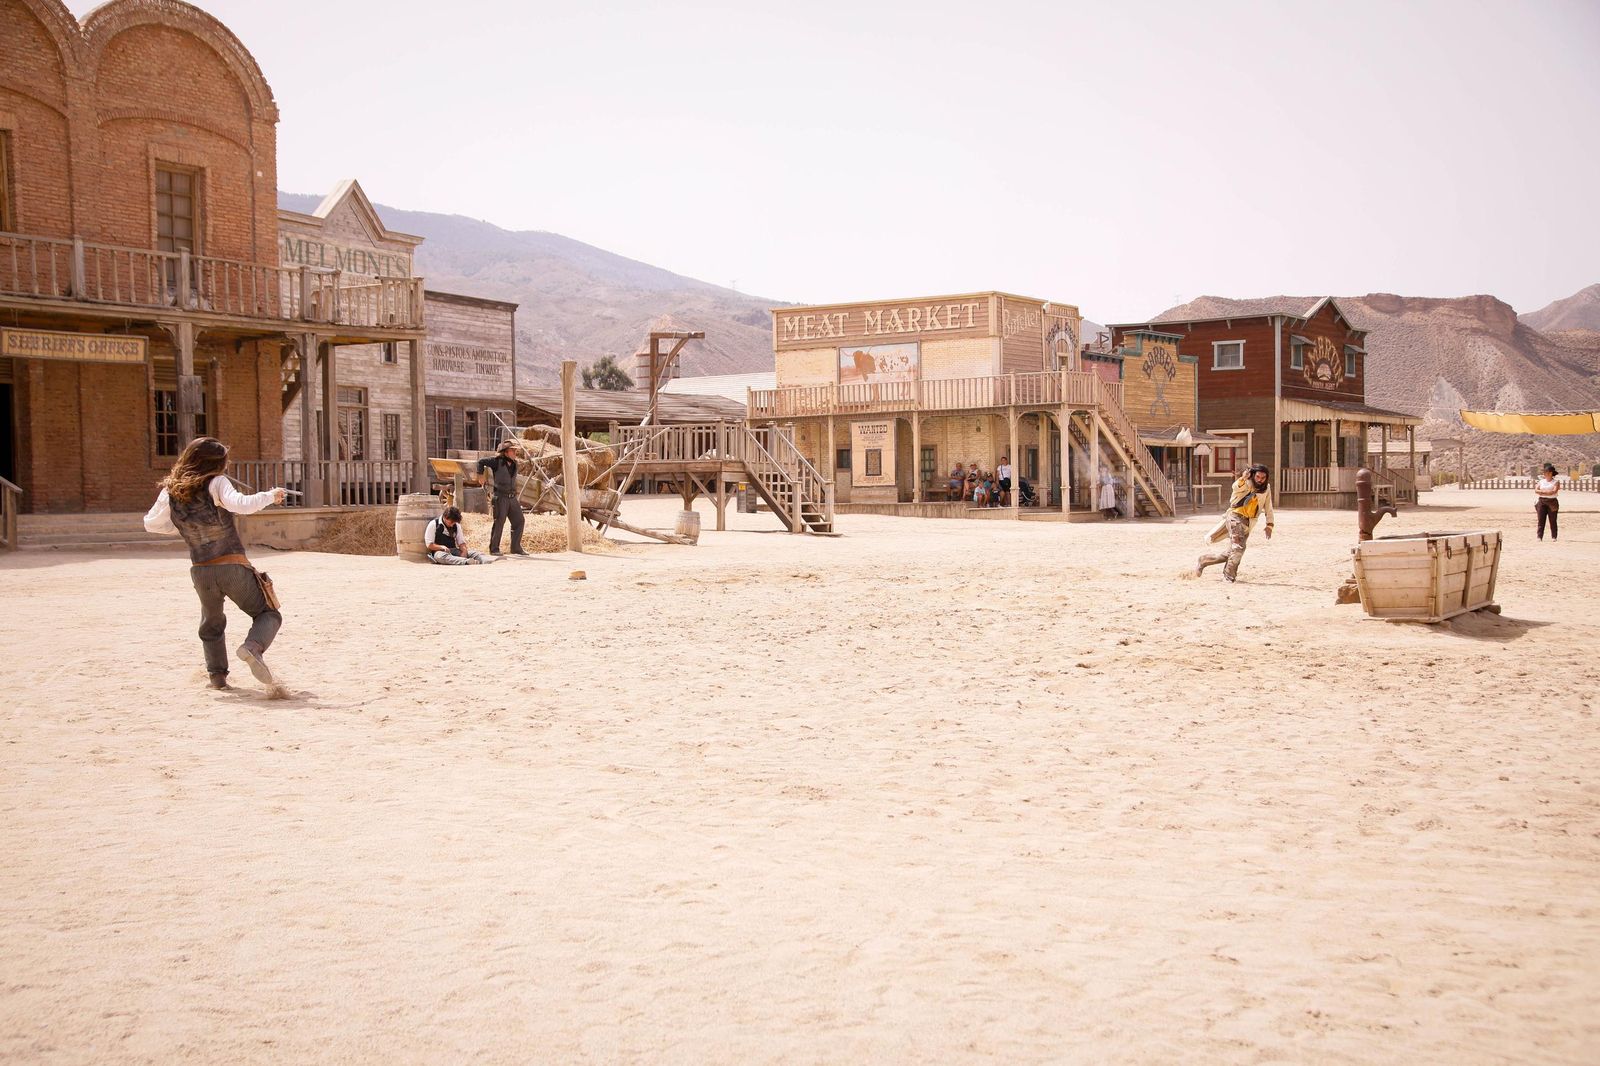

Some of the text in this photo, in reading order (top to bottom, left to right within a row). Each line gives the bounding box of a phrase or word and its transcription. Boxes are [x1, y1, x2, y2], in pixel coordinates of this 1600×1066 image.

[782, 302, 980, 342] MEAT MARKET
[87, 340, 139, 355] OFFICE
[432, 359, 465, 373] HARDWARE
[1142, 346, 1176, 382] BARBER
[858, 424, 888, 435] WANTED
